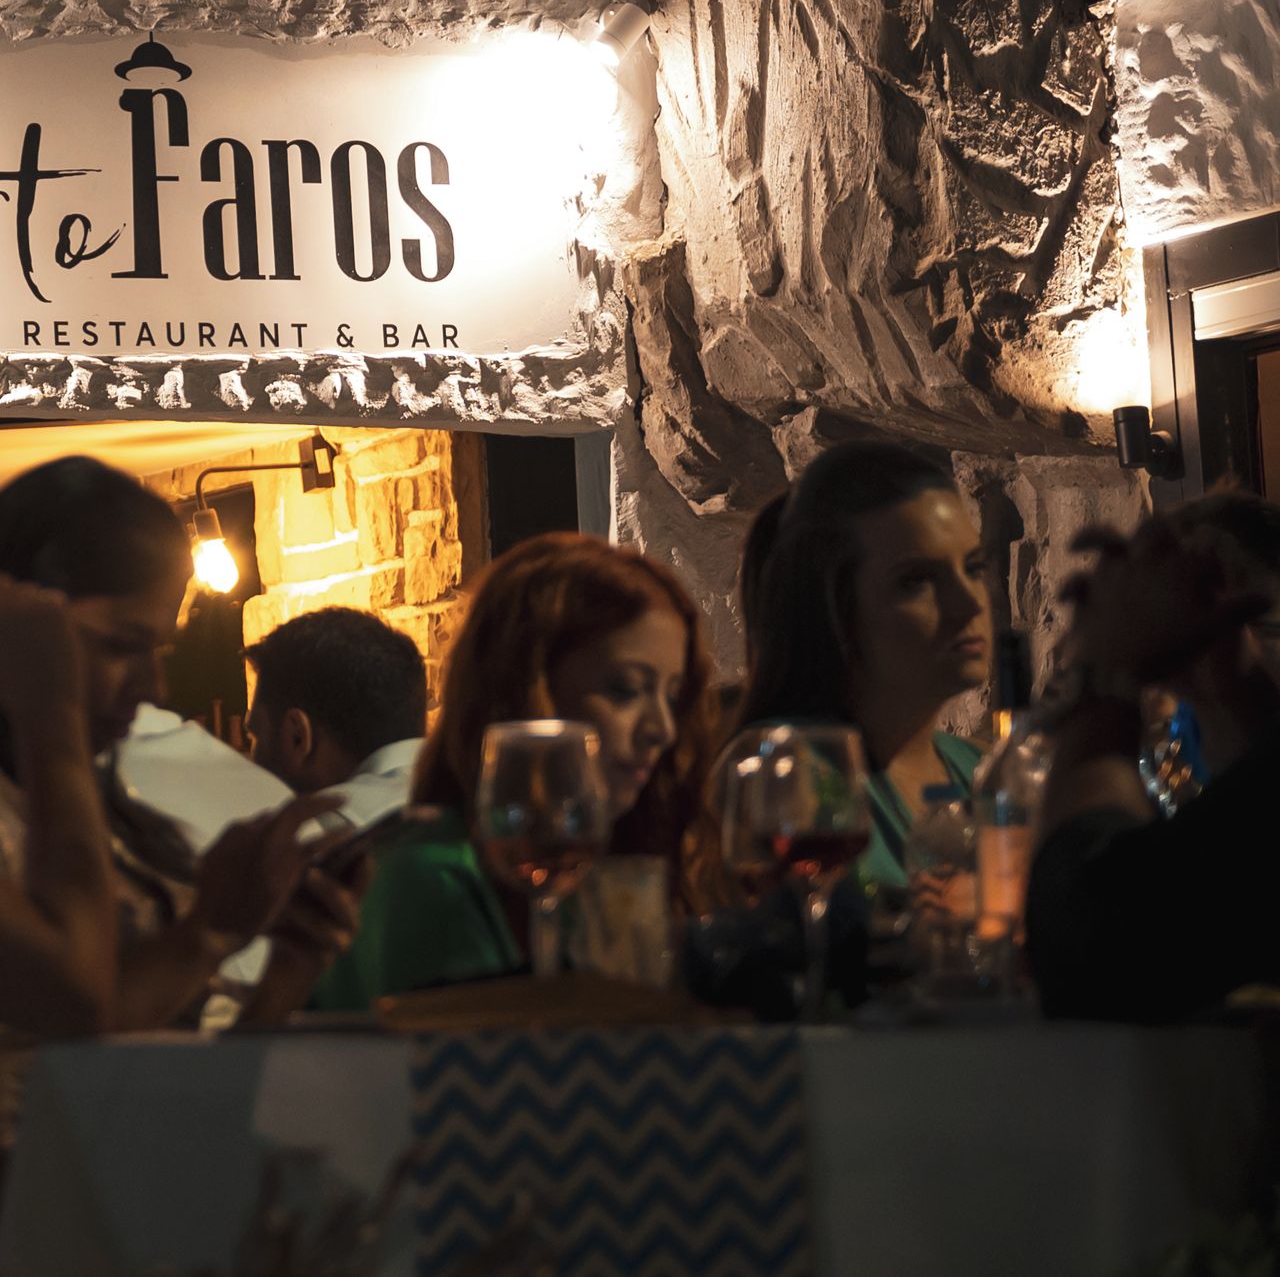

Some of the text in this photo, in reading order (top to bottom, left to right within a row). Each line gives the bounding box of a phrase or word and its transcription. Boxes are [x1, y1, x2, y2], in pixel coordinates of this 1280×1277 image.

[110, 87, 454, 282] Faros
[23, 320, 308, 348] RESTAURANT
[336, 323, 355, 348] &
[382, 323, 459, 348] BAR
